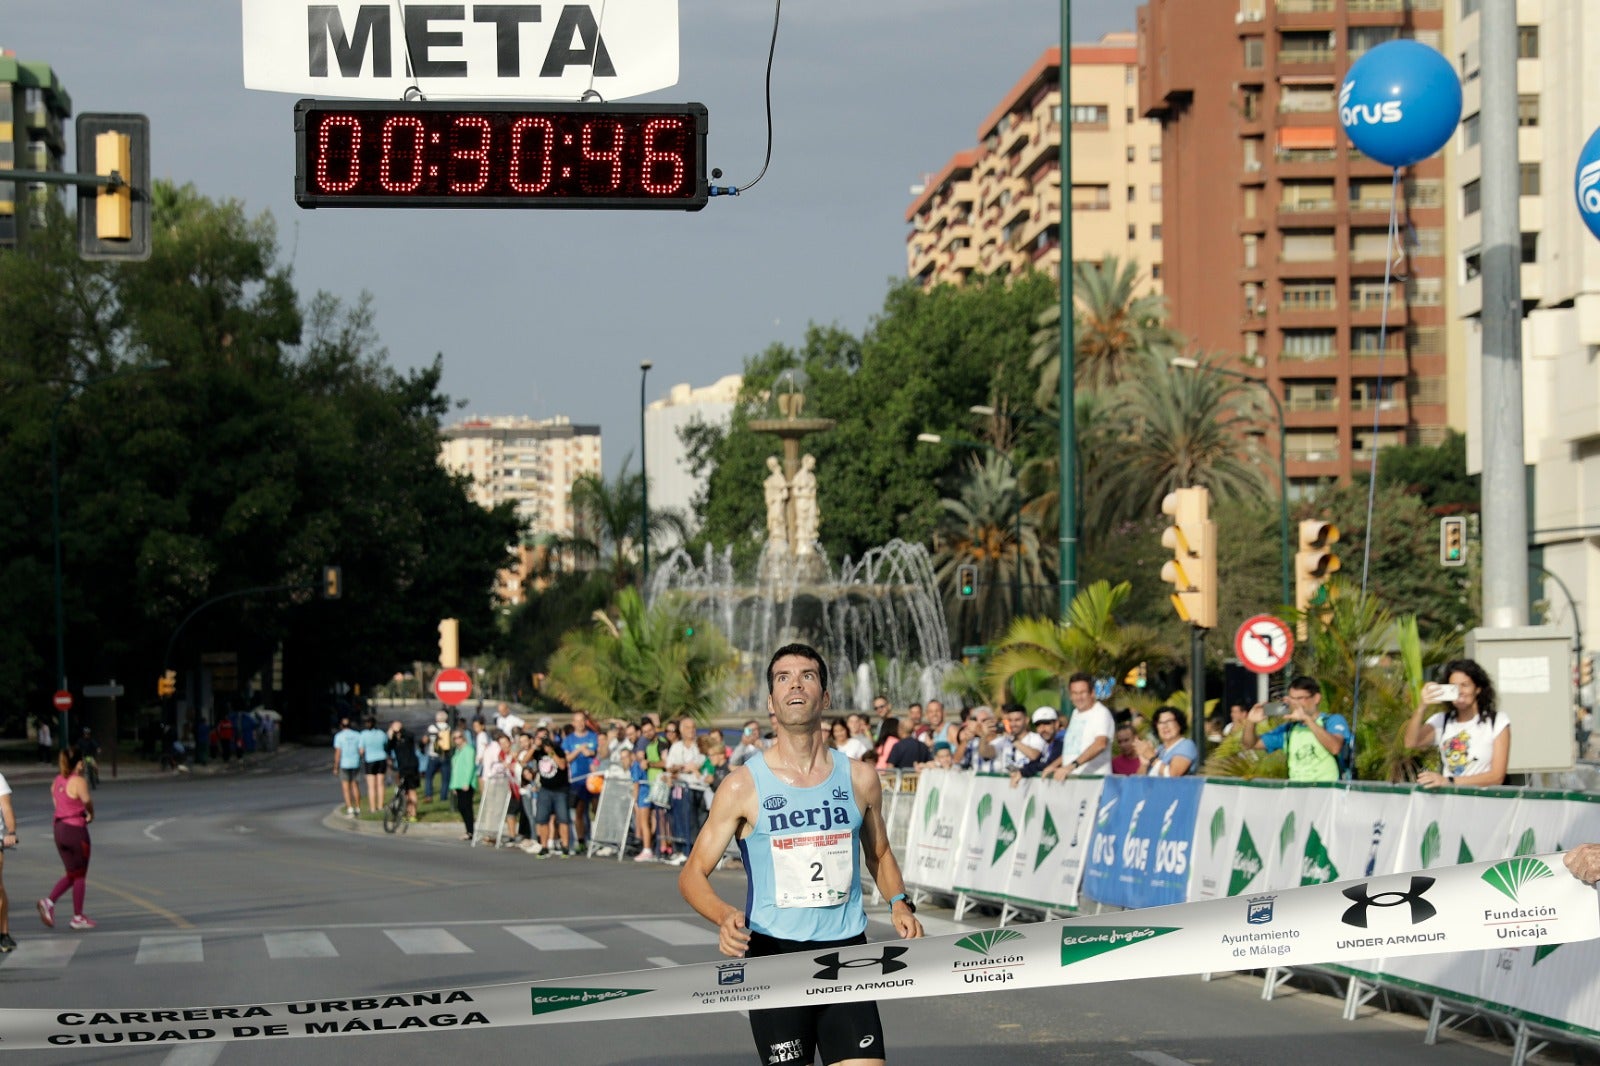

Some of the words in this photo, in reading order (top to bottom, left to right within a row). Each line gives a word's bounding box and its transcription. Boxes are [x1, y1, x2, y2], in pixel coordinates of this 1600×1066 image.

[308, 5, 617, 77] META
[317, 117, 683, 193] 00:30:46
[768, 801, 850, 832] nerja
[773, 838, 793, 849] 42
[810, 862, 824, 881] 2
[1484, 906, 1557, 921] Fundación
[1064, 937, 1076, 946] El
[1077, 933, 1109, 944] Corte
[1110, 928, 1155, 944] Inglés
[1221, 929, 1300, 945] Ayuntamiento
[1497, 924, 1547, 939] Unicaja
[1337, 938, 1383, 949] UNDER
[1386, 932, 1446, 945] ARMOUR
[1232, 947, 1246, 957] de
[1250, 943, 1291, 957] Málaga
[953, 954, 1024, 968] Fundación
[964, 970, 1014, 983] Unicaja
[692, 984, 771, 998] Ayuntamiento
[806, 985, 852, 995] UNDER
[855, 979, 913, 991] ARMOUR
[702, 996, 716, 1004] de
[719, 993, 761, 1003] Málaga
[57, 1006, 272, 1026] CARRERA
[287, 990, 474, 1015] URBANA
[47, 1027, 216, 1045] CIUDAD
[233, 1023, 289, 1038] DE
[305, 1011, 490, 1034] MÁLAGA
